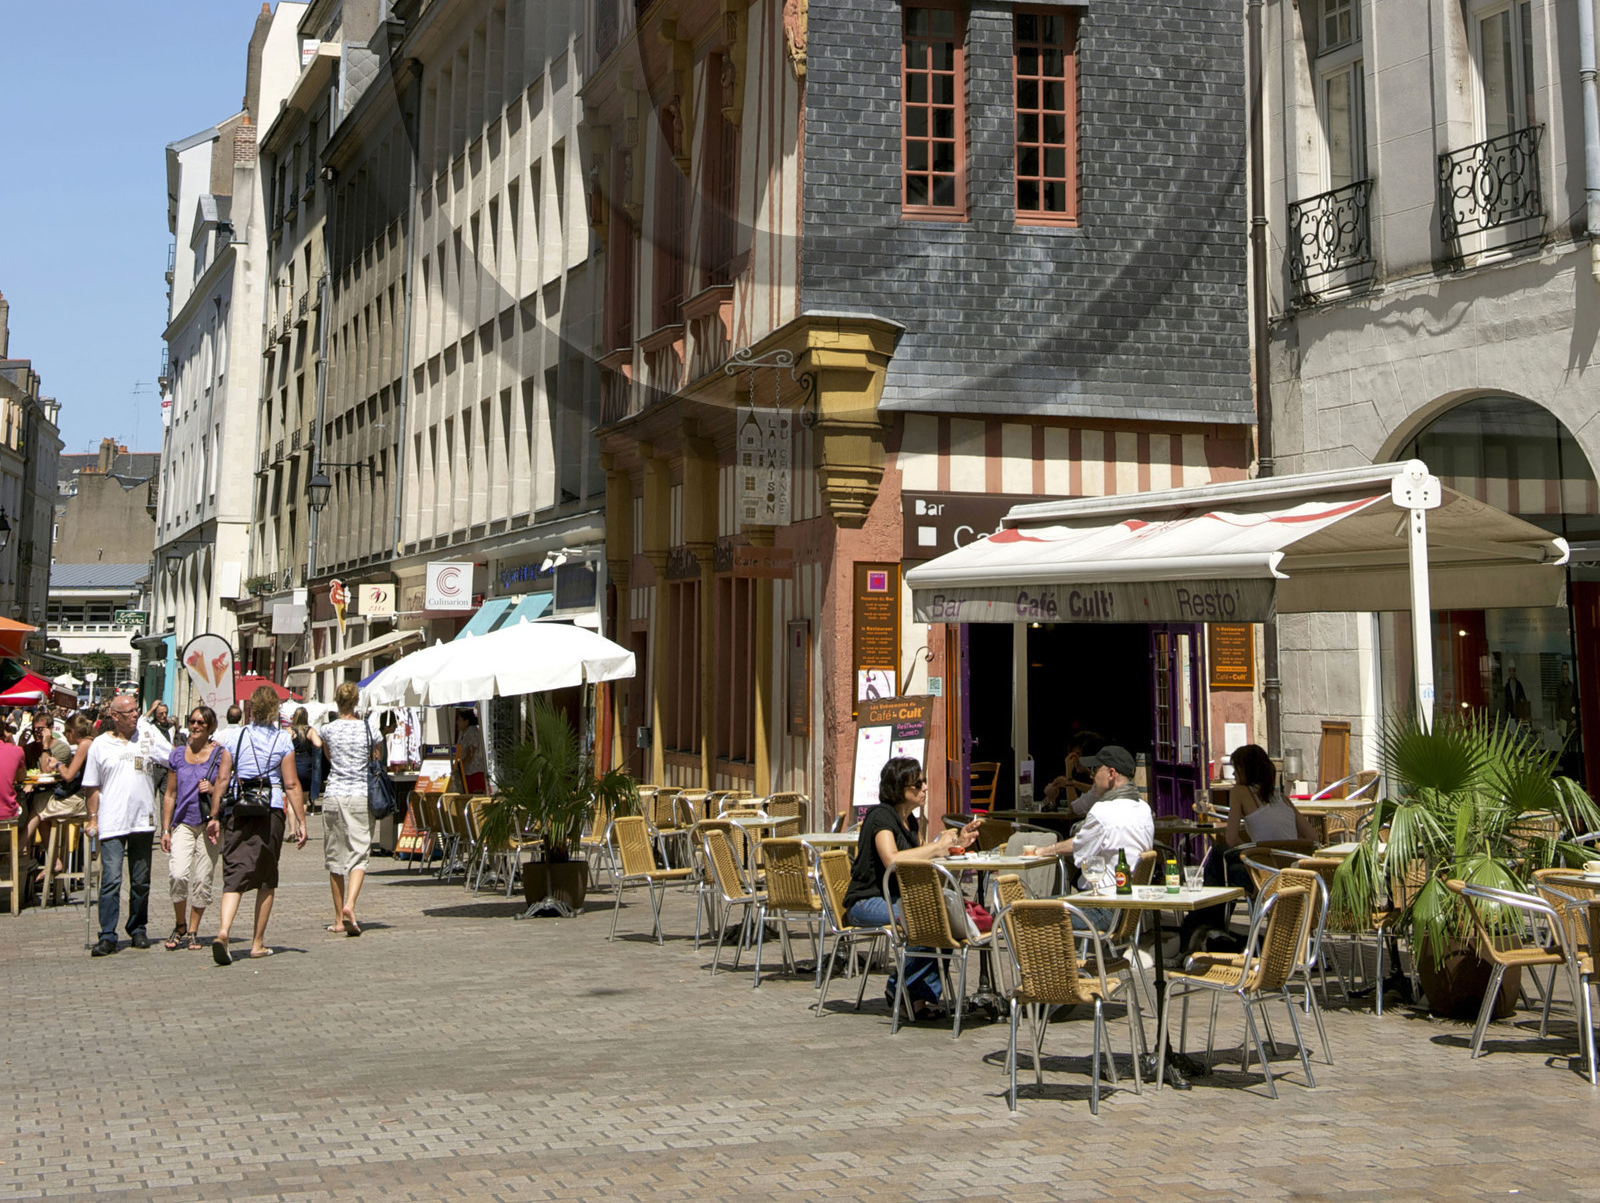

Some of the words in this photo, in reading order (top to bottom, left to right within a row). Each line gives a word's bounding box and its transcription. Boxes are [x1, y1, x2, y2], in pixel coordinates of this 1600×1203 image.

[768, 419, 776, 439] LA
[780, 419, 788, 439] DU
[766, 448, 777, 513] MAISON
[915, 499, 945, 516] Bar
[428, 598, 469, 606] Culinarion
[932, 594, 966, 618] Bar
[1016, 591, 1057, 617] Café
[1069, 590, 1113, 617] Cult'
[1176, 588, 1239, 617] Resto'
[869, 710, 892, 722] Café
